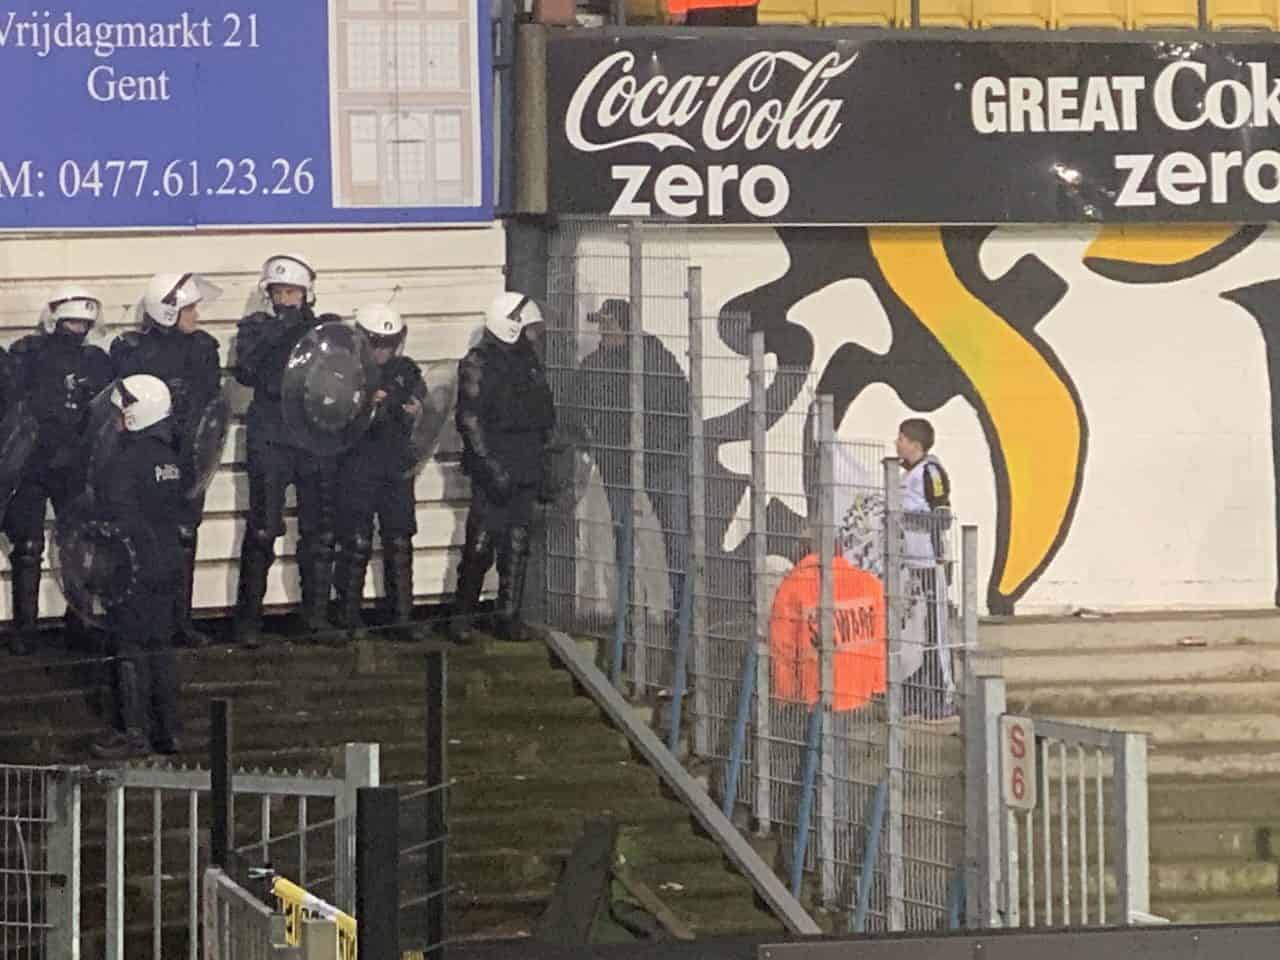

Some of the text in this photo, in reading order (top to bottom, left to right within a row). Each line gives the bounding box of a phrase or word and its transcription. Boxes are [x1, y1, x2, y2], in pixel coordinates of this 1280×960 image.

[222, 12, 261, 48] 21
[86, 65, 170, 102] Gent
[565, 50, 860, 152] Coca-Cola
[971, 75, 1145, 134] GREAT
[58, 157, 315, 198] 0477.61.23.26
[609, 163, 791, 218] zero
[1114, 149, 1280, 208] zero
